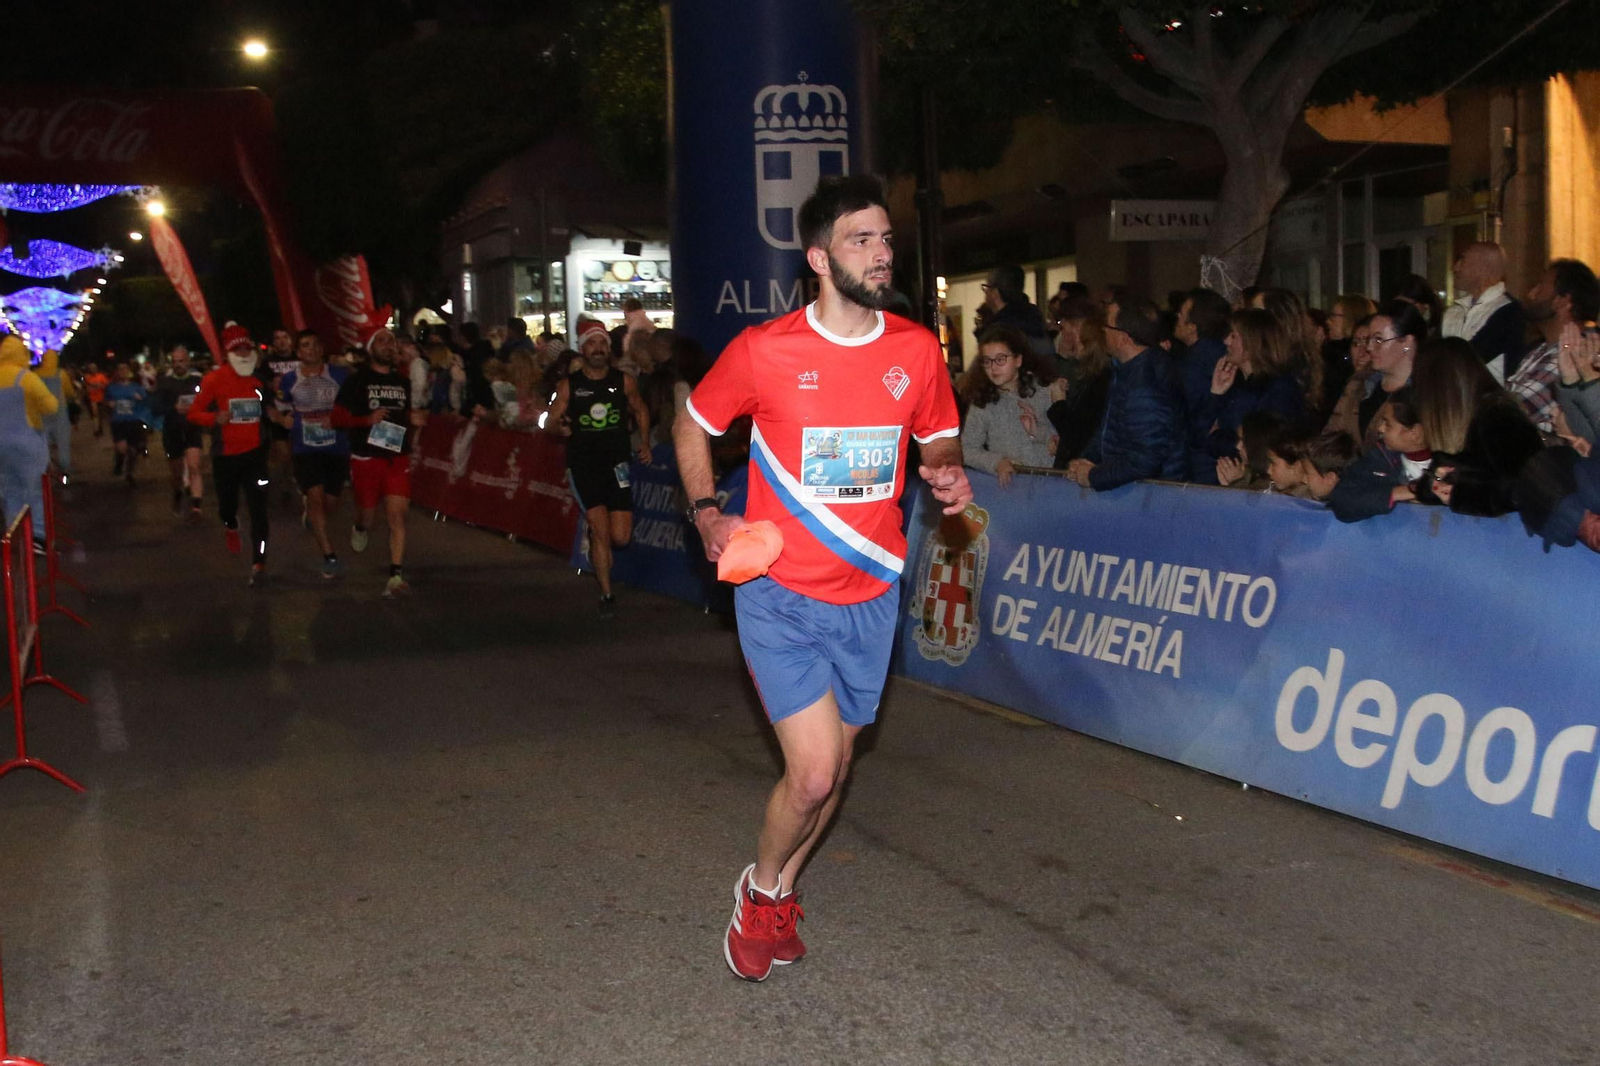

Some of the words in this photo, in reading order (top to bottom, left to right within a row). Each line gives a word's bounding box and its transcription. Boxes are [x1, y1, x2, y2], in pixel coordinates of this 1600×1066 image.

[844, 447, 894, 469] 1303
[1003, 543, 1277, 628] AYUNTAMIENTO
[991, 594, 1038, 641] DE
[1036, 606, 1185, 678] ALMERÍA
